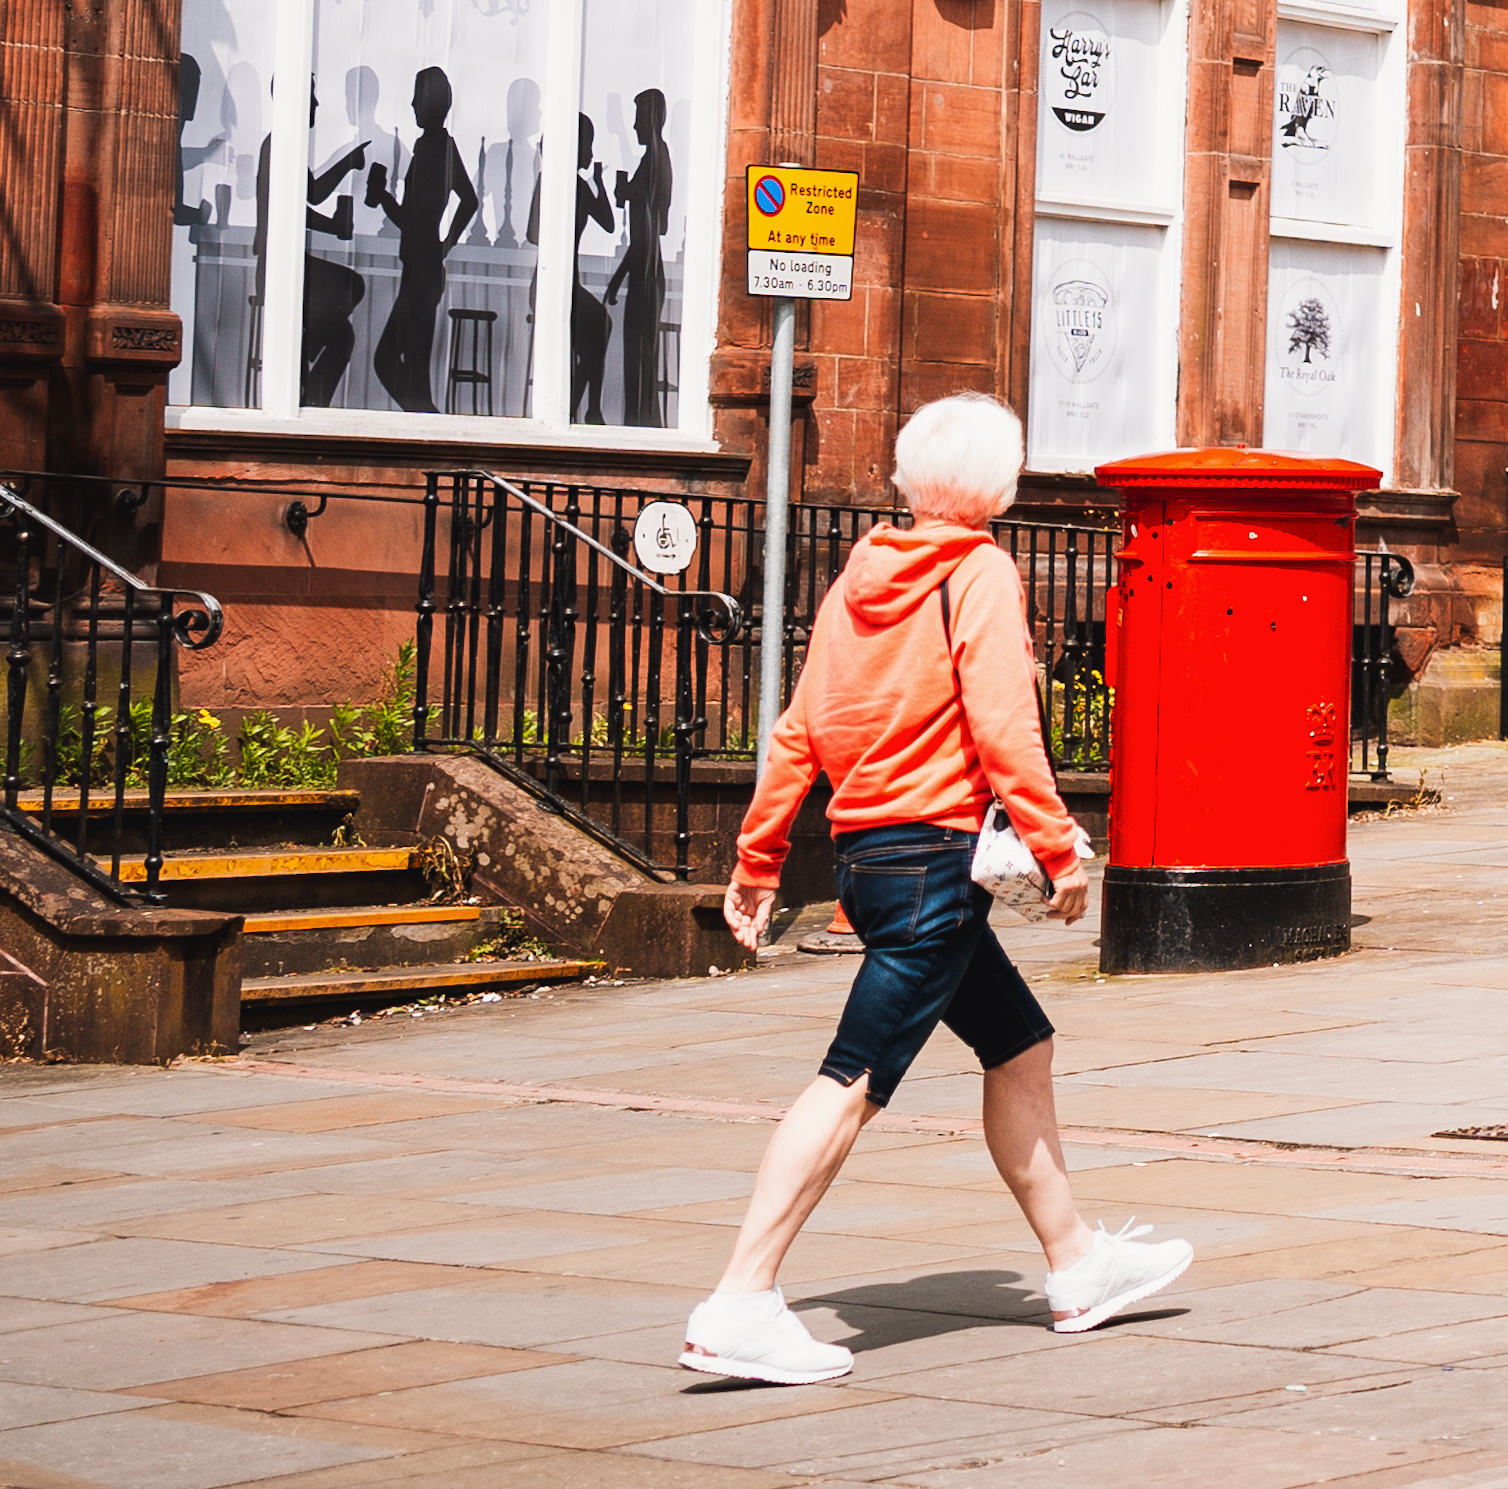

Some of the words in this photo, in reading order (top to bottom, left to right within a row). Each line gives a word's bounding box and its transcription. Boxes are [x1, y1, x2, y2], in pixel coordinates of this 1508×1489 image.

[1050, 27, 1111, 68] Harry's
[1060, 65, 1100, 100] Bar
[1281, 82, 1298, 93] THE
[1278, 92, 1336, 119] RAVEN
[1064, 111, 1095, 126] WIGAN
[790, 183, 853, 199] Restricted
[806, 201, 835, 215] Zone
[767, 229, 781, 243] At
[785, 233, 807, 246] any
[810, 232, 836, 246] time
[769, 258, 786, 272] No
[790, 259, 832, 277] loading
[753, 275, 794, 290] 7.30am
[807, 279, 848, 294] 6.30pm
[1280, 366, 1294, 379] The
[1296, 368, 1318, 384] Royal
[1318, 369, 1336, 382] Oak
